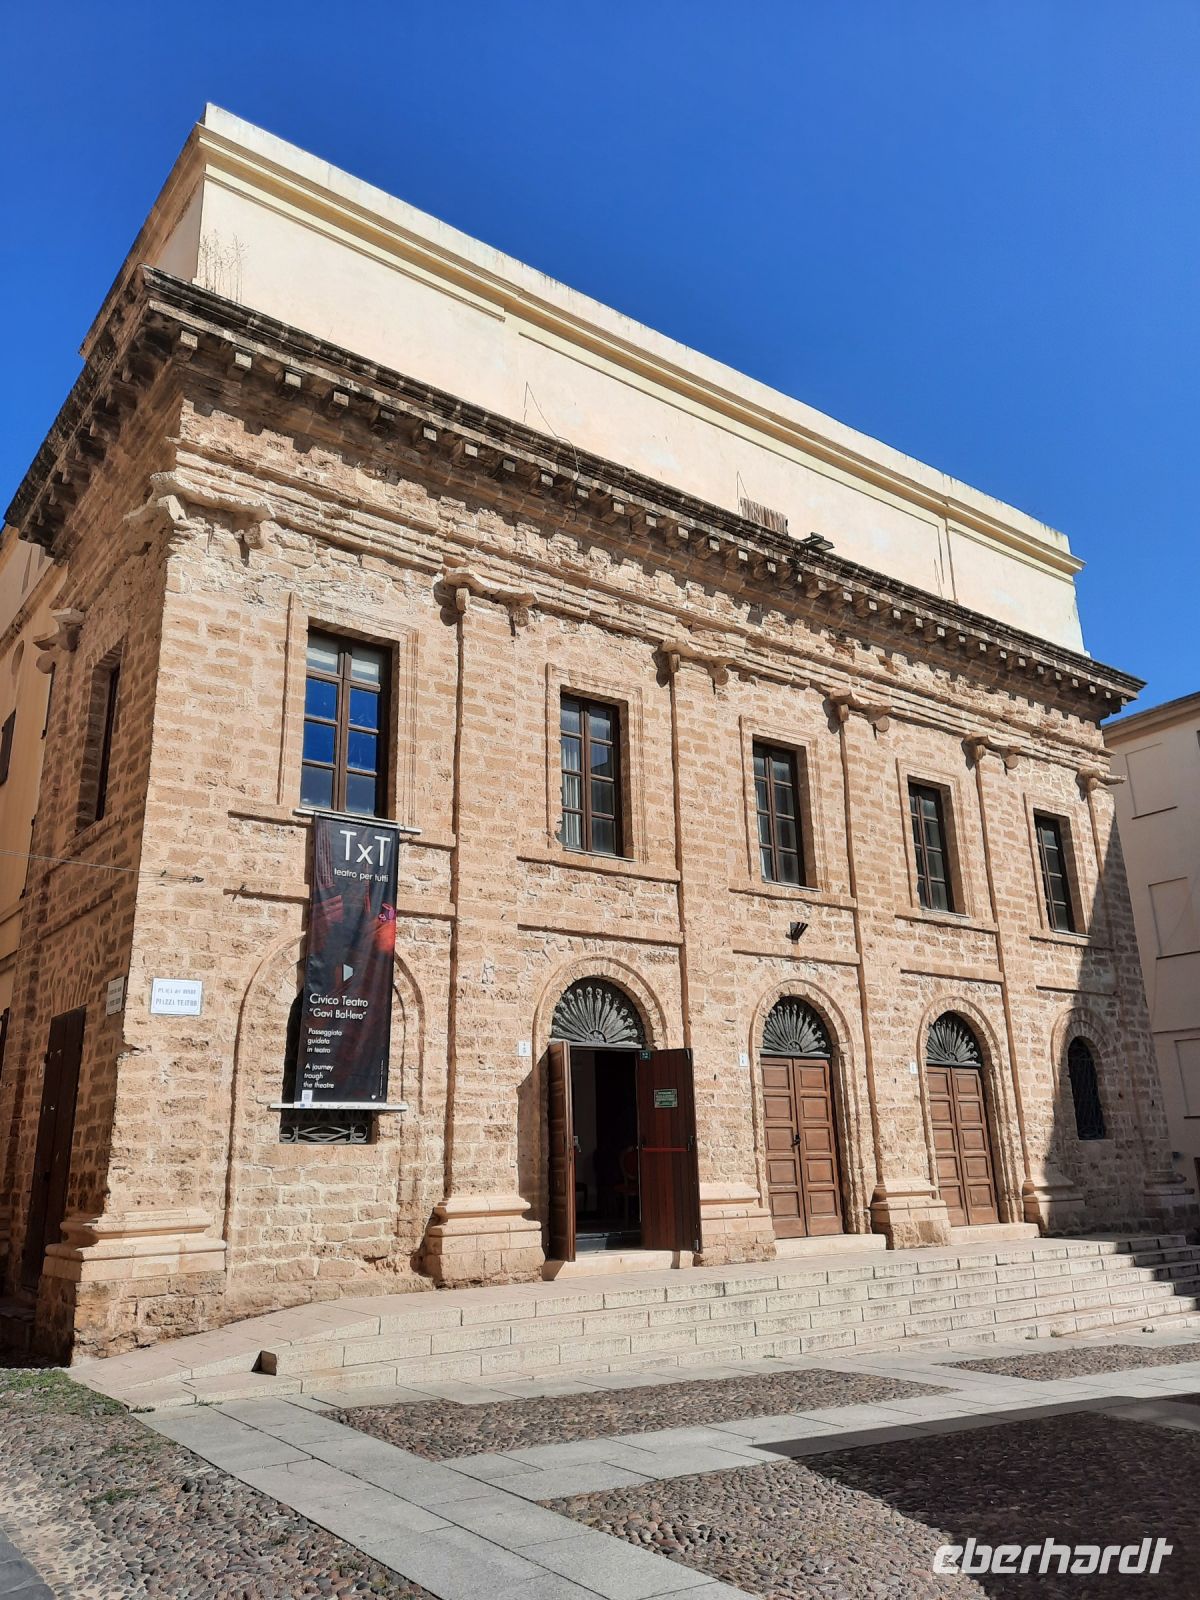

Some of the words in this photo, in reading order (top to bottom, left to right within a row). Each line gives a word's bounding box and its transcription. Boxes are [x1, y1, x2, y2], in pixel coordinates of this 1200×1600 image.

[340, 829, 391, 867] TxT
[334, 867, 357, 878] teatro
[359, 873, 373, 881] per
[375, 874, 389, 882] tutti
[309, 993, 339, 1005] Civico
[341, 995, 369, 1007] Teatro
[308, 1027, 343, 1037] Passeggiata
[307, 1037, 330, 1045] guidata
[311, 1064, 334, 1072] journey
[314, 1081, 335, 1089] theatre
